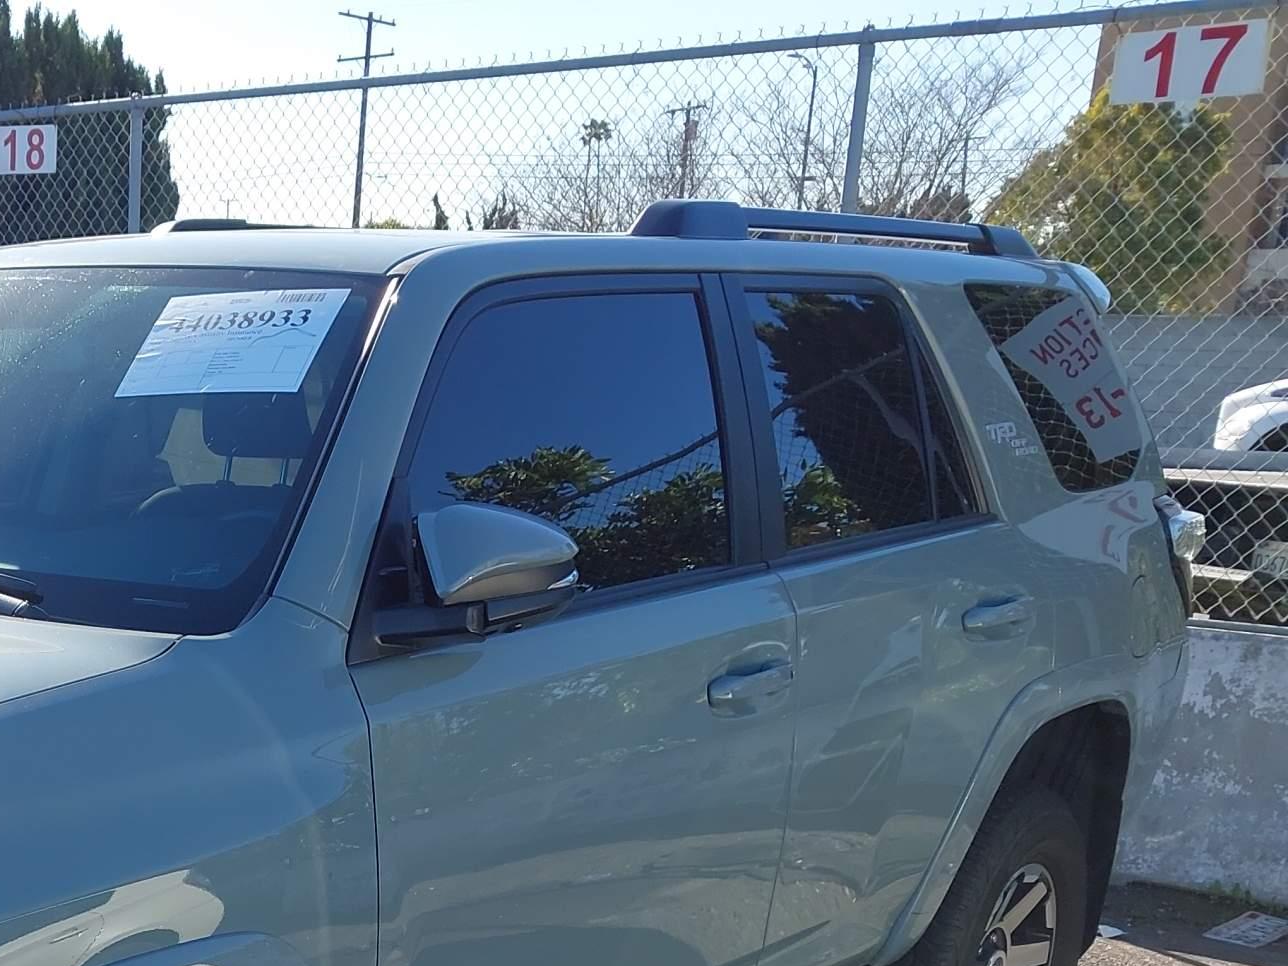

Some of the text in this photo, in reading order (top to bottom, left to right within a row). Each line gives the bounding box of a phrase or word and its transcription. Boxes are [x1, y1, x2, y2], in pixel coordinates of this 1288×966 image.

[1144, 24, 1248, 98] 17
[4, 128, 44, 171] 18
[167, 309, 312, 334] 44038933
[985, 422, 1016, 444] TRD
